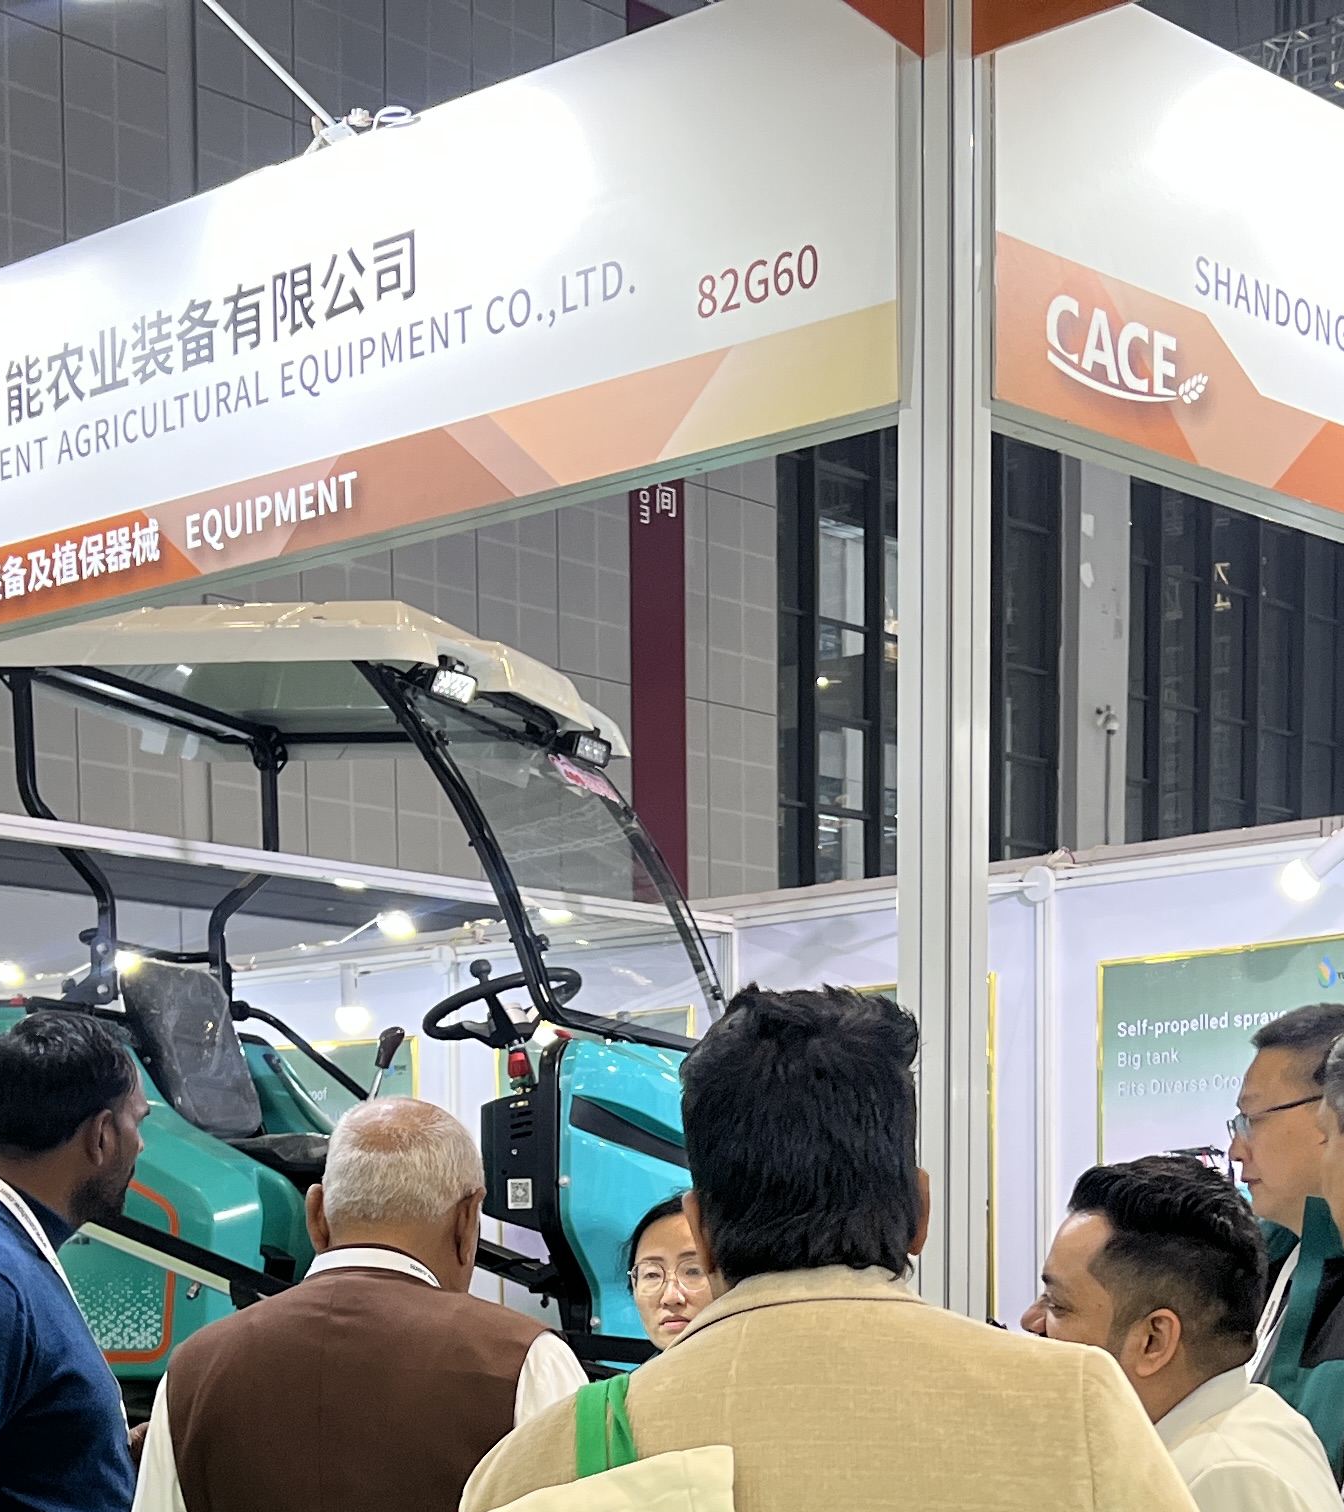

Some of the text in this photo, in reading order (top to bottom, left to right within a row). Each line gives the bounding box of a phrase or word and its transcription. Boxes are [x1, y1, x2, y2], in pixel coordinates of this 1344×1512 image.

[696, 244, 820, 320] 82G60
[57, 370, 269, 466] AGRICULTURAL
[280, 304, 472, 400] EQUIPMENT
[485, 259, 636, 338] CO.,LTD.
[1046, 294, 1178, 398] CACE
[185, 470, 359, 551] EQUIPMENT
[1117, 1011, 1229, 1038] Self-propelled
[1117, 1048, 1180, 1070] Big tank
[1117, 1081, 1146, 1097] Fits
[1150, 1077, 1208, 1095] Diverse
